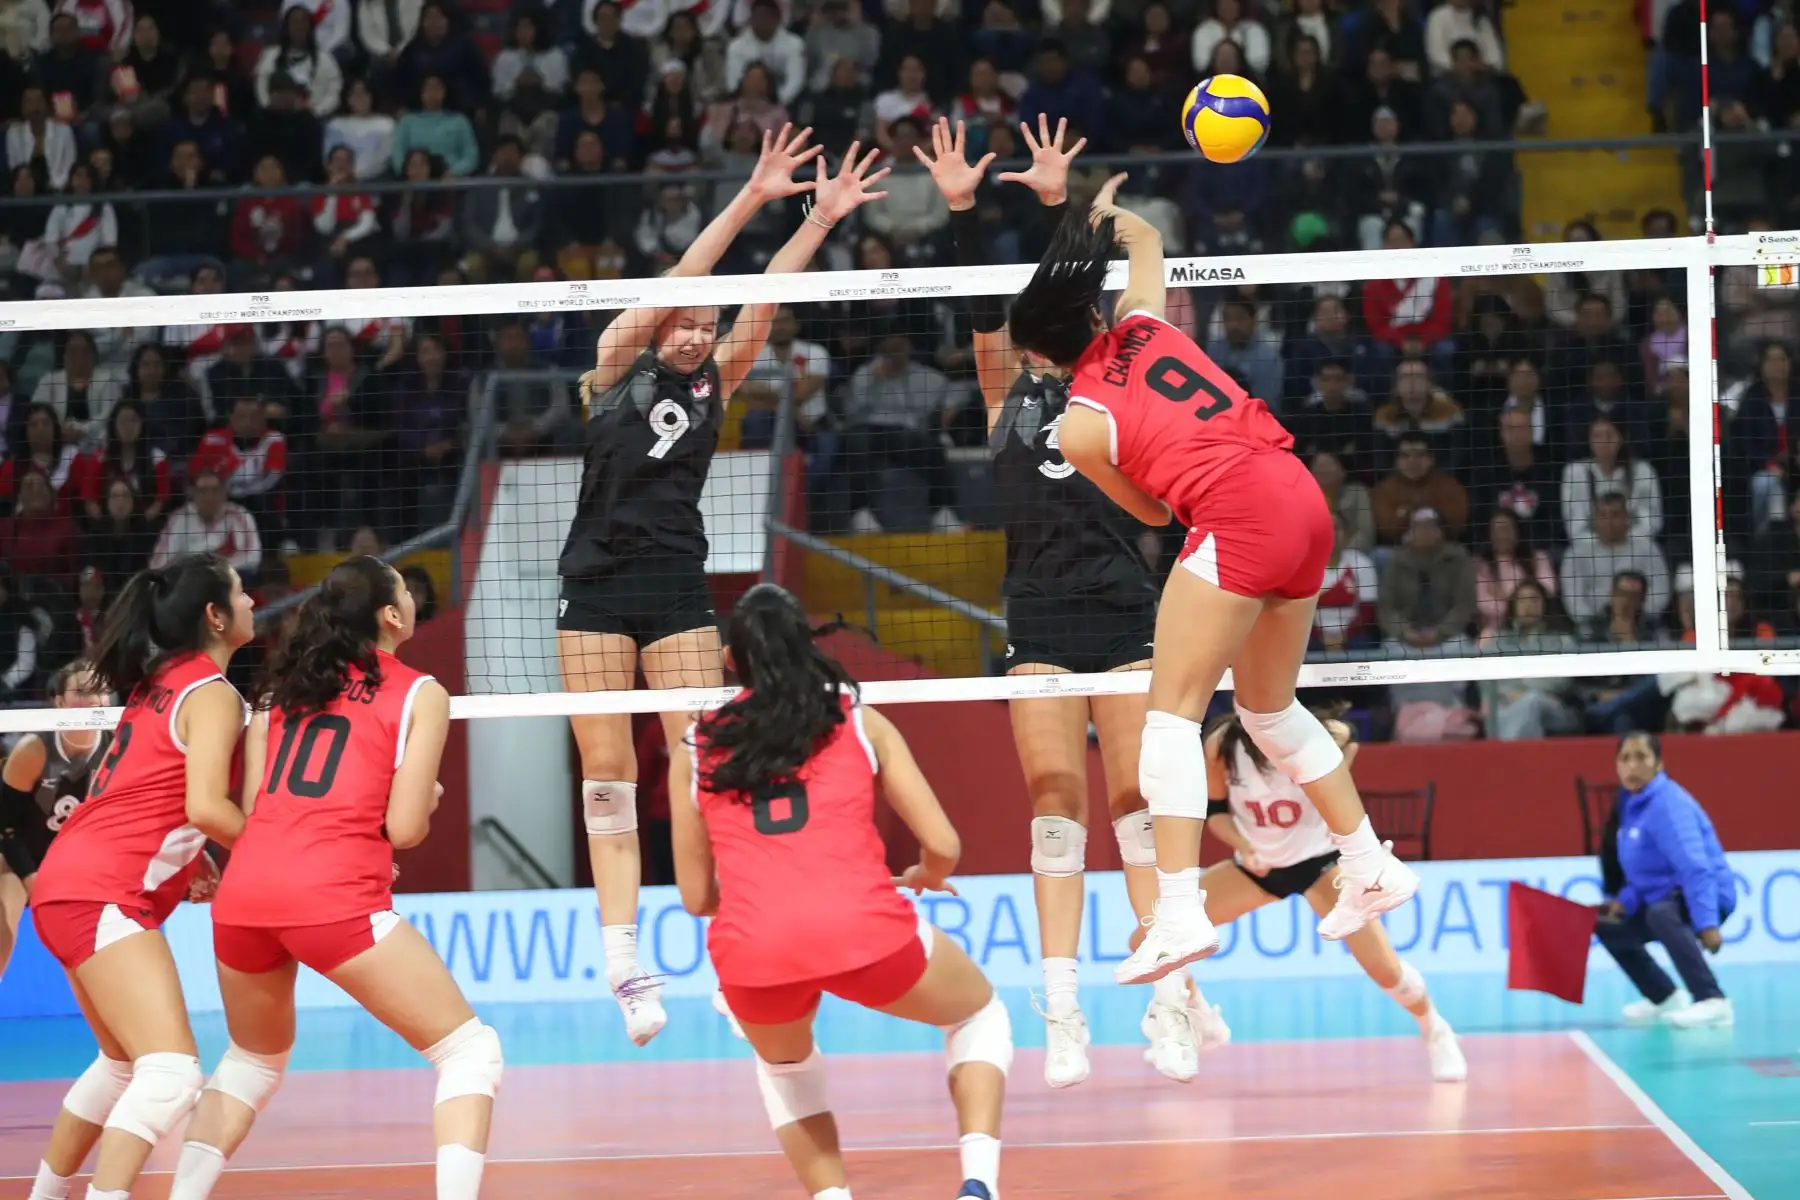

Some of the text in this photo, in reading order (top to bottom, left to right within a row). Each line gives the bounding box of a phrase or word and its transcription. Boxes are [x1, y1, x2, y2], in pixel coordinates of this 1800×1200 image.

[1502, 262, 1526, 270] WORLD
[1529, 260, 1584, 268] CHAMPIONSHIP
[586, 297, 640, 305] CHAMPIONSHIP
[870, 287, 895, 295] WORLD
[897, 285, 952, 294] CHAMPIONSHIP
[267, 308, 322, 316] CHAMPIONSHIP
[1103, 319, 1160, 388] CHANCA
[1145, 356, 1232, 421] 9
[647, 398, 690, 459] 9
[267, 713, 351, 798] 10
[1245, 799, 1302, 829] 10
